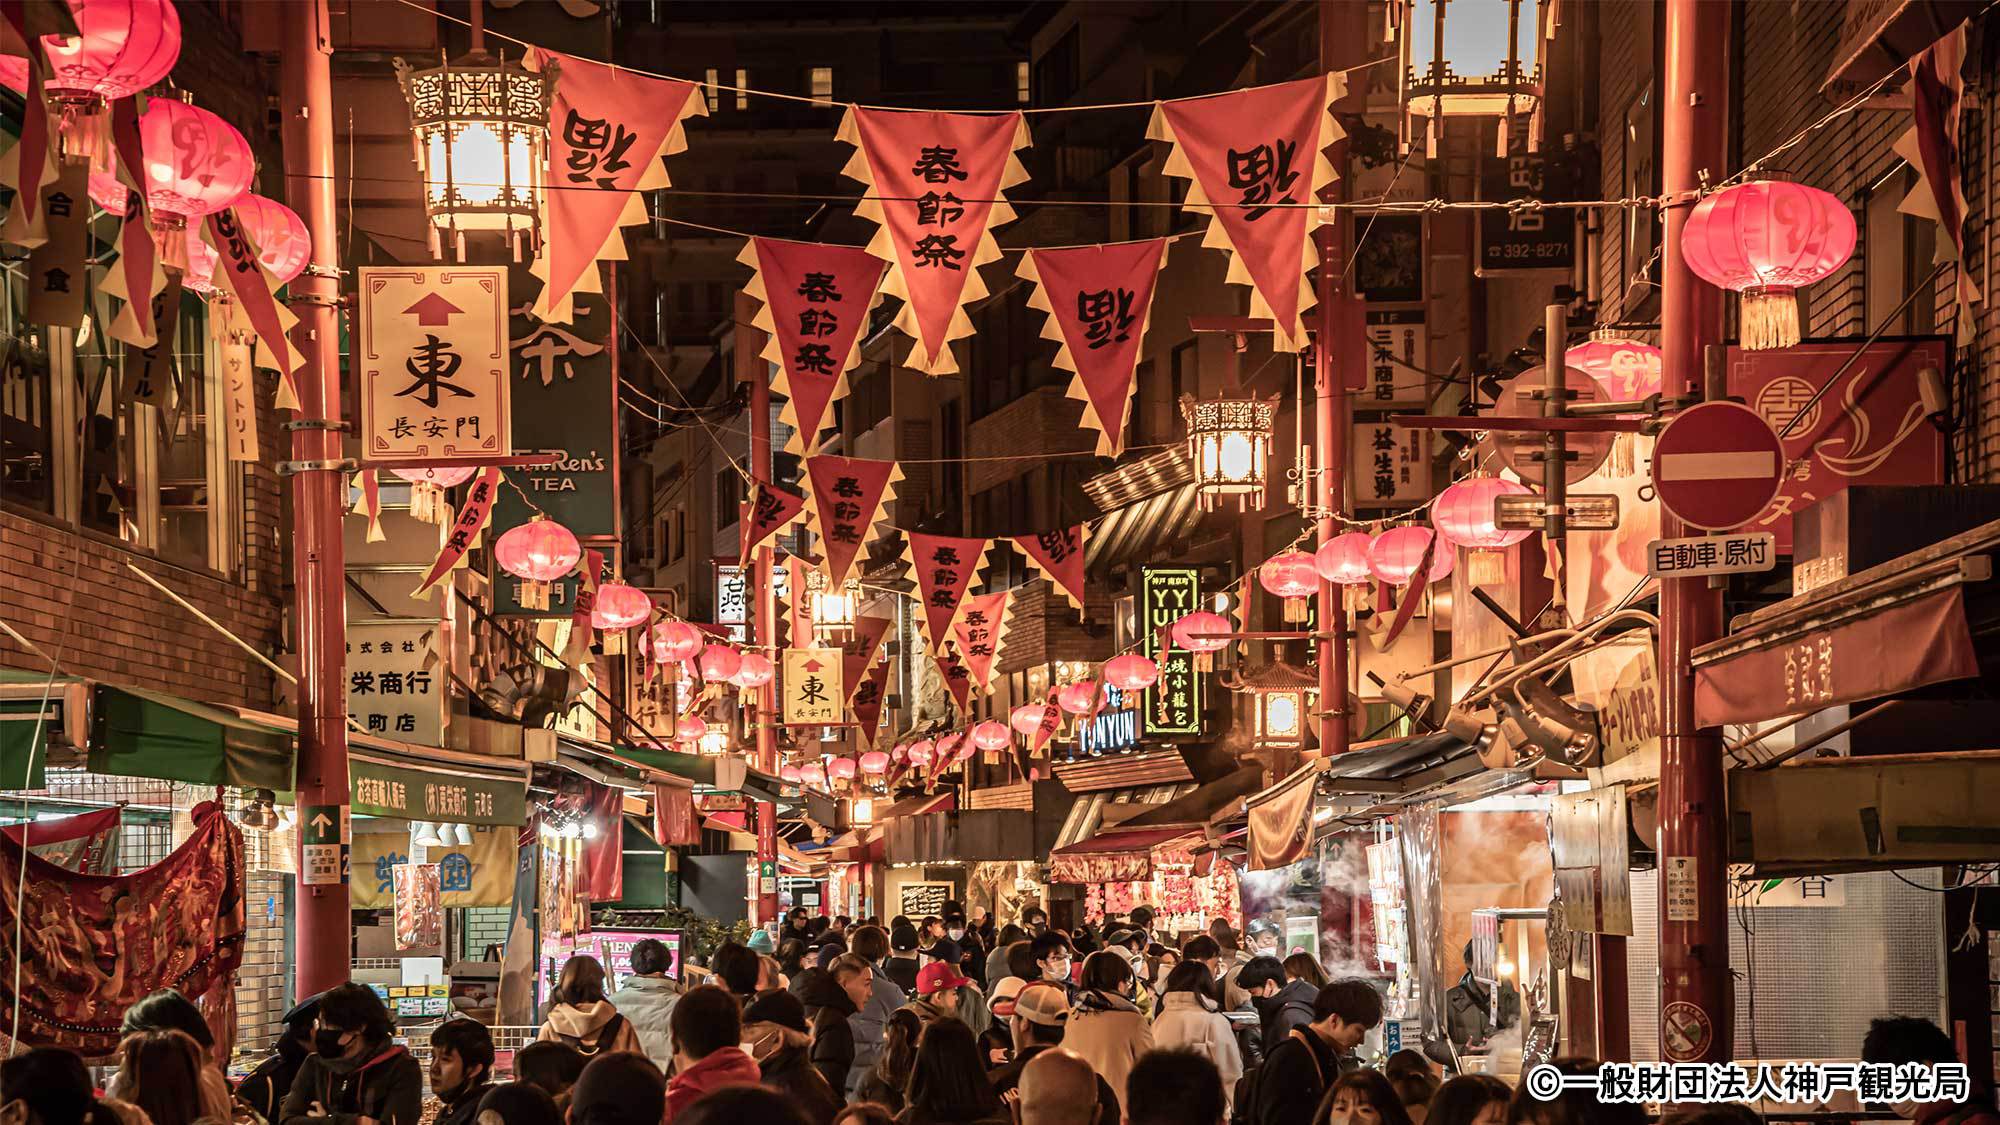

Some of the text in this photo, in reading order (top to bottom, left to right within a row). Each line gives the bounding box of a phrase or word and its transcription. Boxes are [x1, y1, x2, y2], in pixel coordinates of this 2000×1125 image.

[1226, 138, 1301, 221] 福
[911, 145, 968, 270] 春節祭
[1503, 243, 1569, 258] 392-8271
[794, 271, 842, 376] 春節祭
[1077, 287, 1136, 350] 福
[393, 334, 476, 409] 東
[229, 357, 248, 455] サントリー
[387, 415, 481, 440] 長安門
[530, 477, 577, 492] TEA
[831, 476, 863, 544] 春節祭
[931, 546, 961, 608] 春節祭
[1655, 537, 1768, 572] 自動車・原付
[965, 610, 993, 657] 春節祭
[351, 671, 432, 695] 栄商行
[798, 676, 829, 706] 東
[794, 708, 832, 719] 長安門
